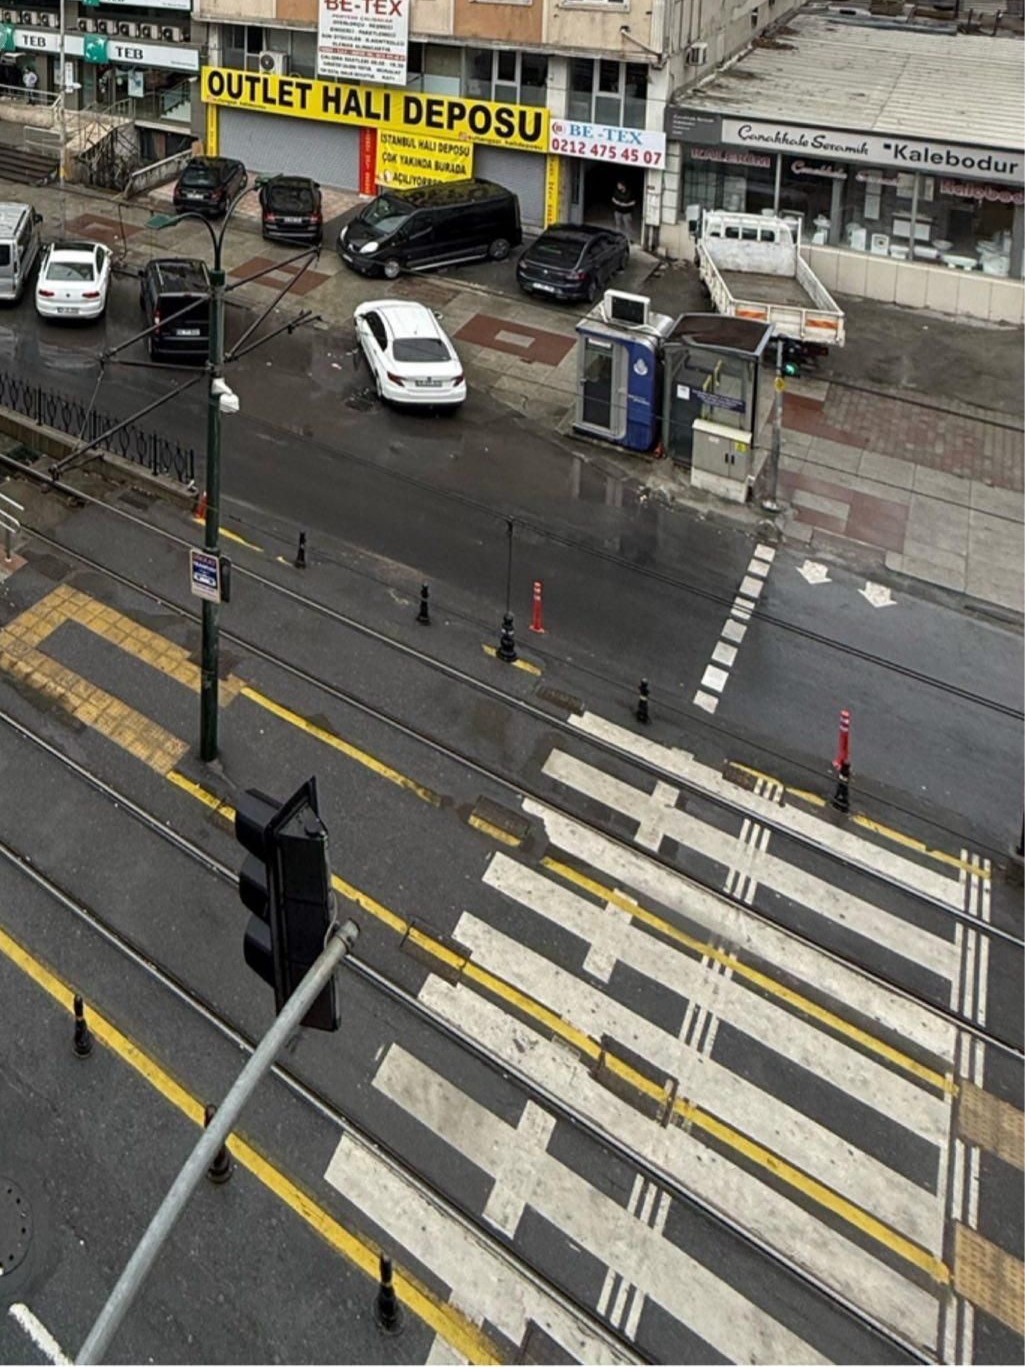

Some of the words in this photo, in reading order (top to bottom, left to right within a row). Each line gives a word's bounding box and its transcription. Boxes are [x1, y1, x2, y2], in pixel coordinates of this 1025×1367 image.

[22, 34, 47, 47] TEB
[115, 46, 144, 59] TEB
[208, 70, 313, 109] OUTLET
[323, 85, 391, 122] HALI
[403, 95, 542, 143] DEPOSU
[437, 142, 470, 157] DEPOSU
[551, 138, 586, 154] 0212
[590, 143, 617, 159] 475
[621, 148, 639, 162] 45
[643, 151, 662, 165] 07
[811, 135, 870, 155] Seramik
[893, 143, 1019, 175] Kalebodur
[400, 155, 433, 170] YAKINDA
[434, 159, 467, 175] BURADA
